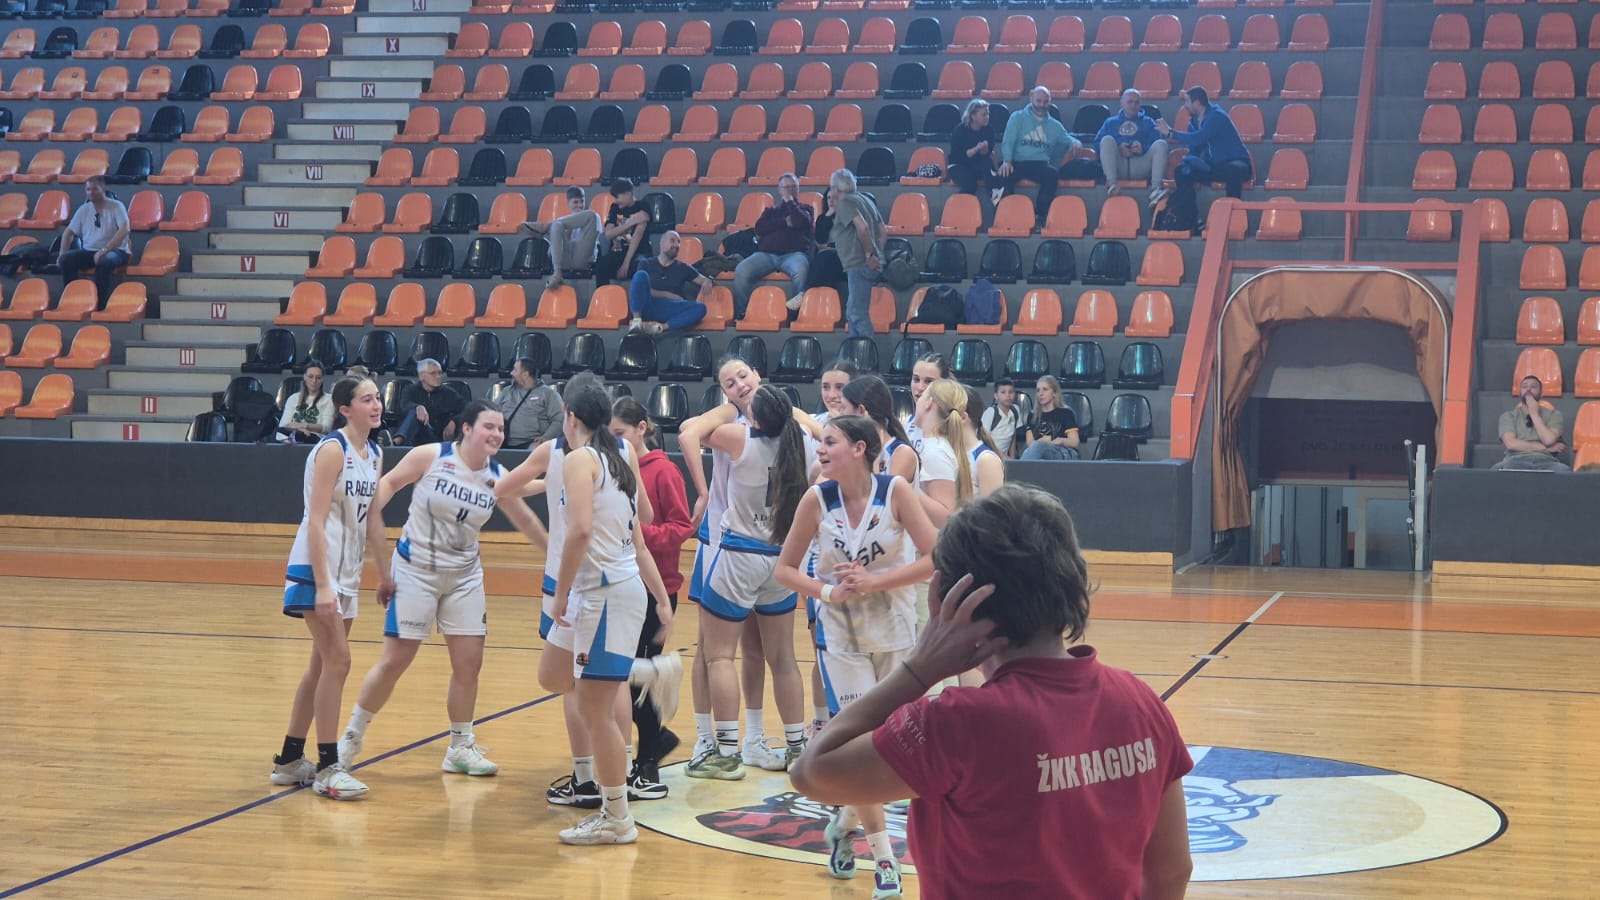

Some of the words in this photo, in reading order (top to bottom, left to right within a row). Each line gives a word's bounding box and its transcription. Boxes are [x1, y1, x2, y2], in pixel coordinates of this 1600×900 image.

[389, 39, 397, 52] X
[362, 84, 374, 97] IX
[335, 126, 354, 139] VIII
[306, 166, 322, 179] VII
[275, 213, 288, 227] VI
[244, 257, 253, 271] V
[212, 304, 226, 318] IV
[181, 350, 194, 364] III
[145, 398, 154, 412] II
[345, 480, 377, 497] RAGUS
[1036, 753, 1081, 793] ŽKK
[1080, 737, 1157, 785] RAGUSA
